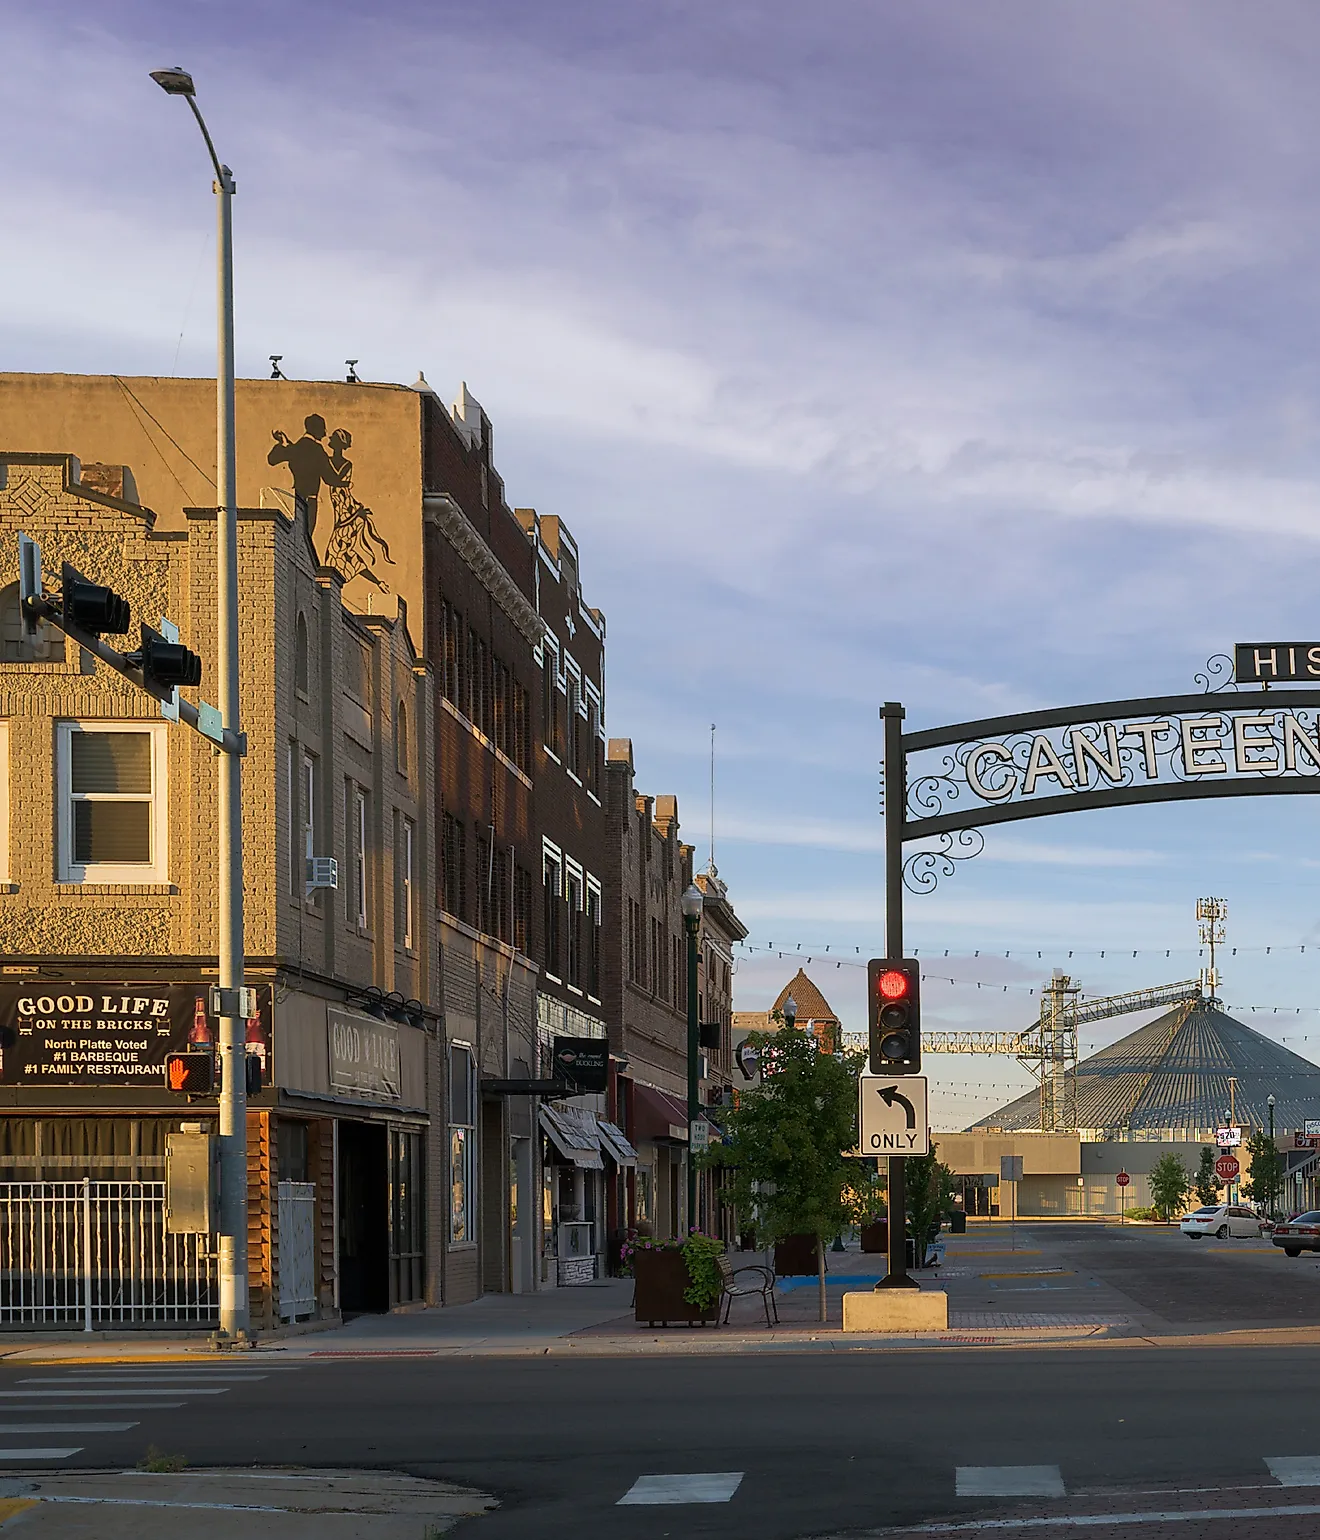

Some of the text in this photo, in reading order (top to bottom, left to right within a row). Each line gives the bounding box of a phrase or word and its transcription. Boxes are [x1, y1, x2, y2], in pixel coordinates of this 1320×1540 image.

[17, 995, 170, 1017] GOOD LIFE
[35, 1019, 153, 1031] ON THE BRICKS
[44, 1039, 147, 1049] North Platte Voted
[333, 1022, 360, 1063] GOOD
[53, 1052, 139, 1063] #1 BARBEQUE
[24, 1064, 166, 1075] #1 FAMILY RESTAURANT
[870, 1133, 917, 1149] ONLY
[1217, 1162, 1239, 1172] STOP
